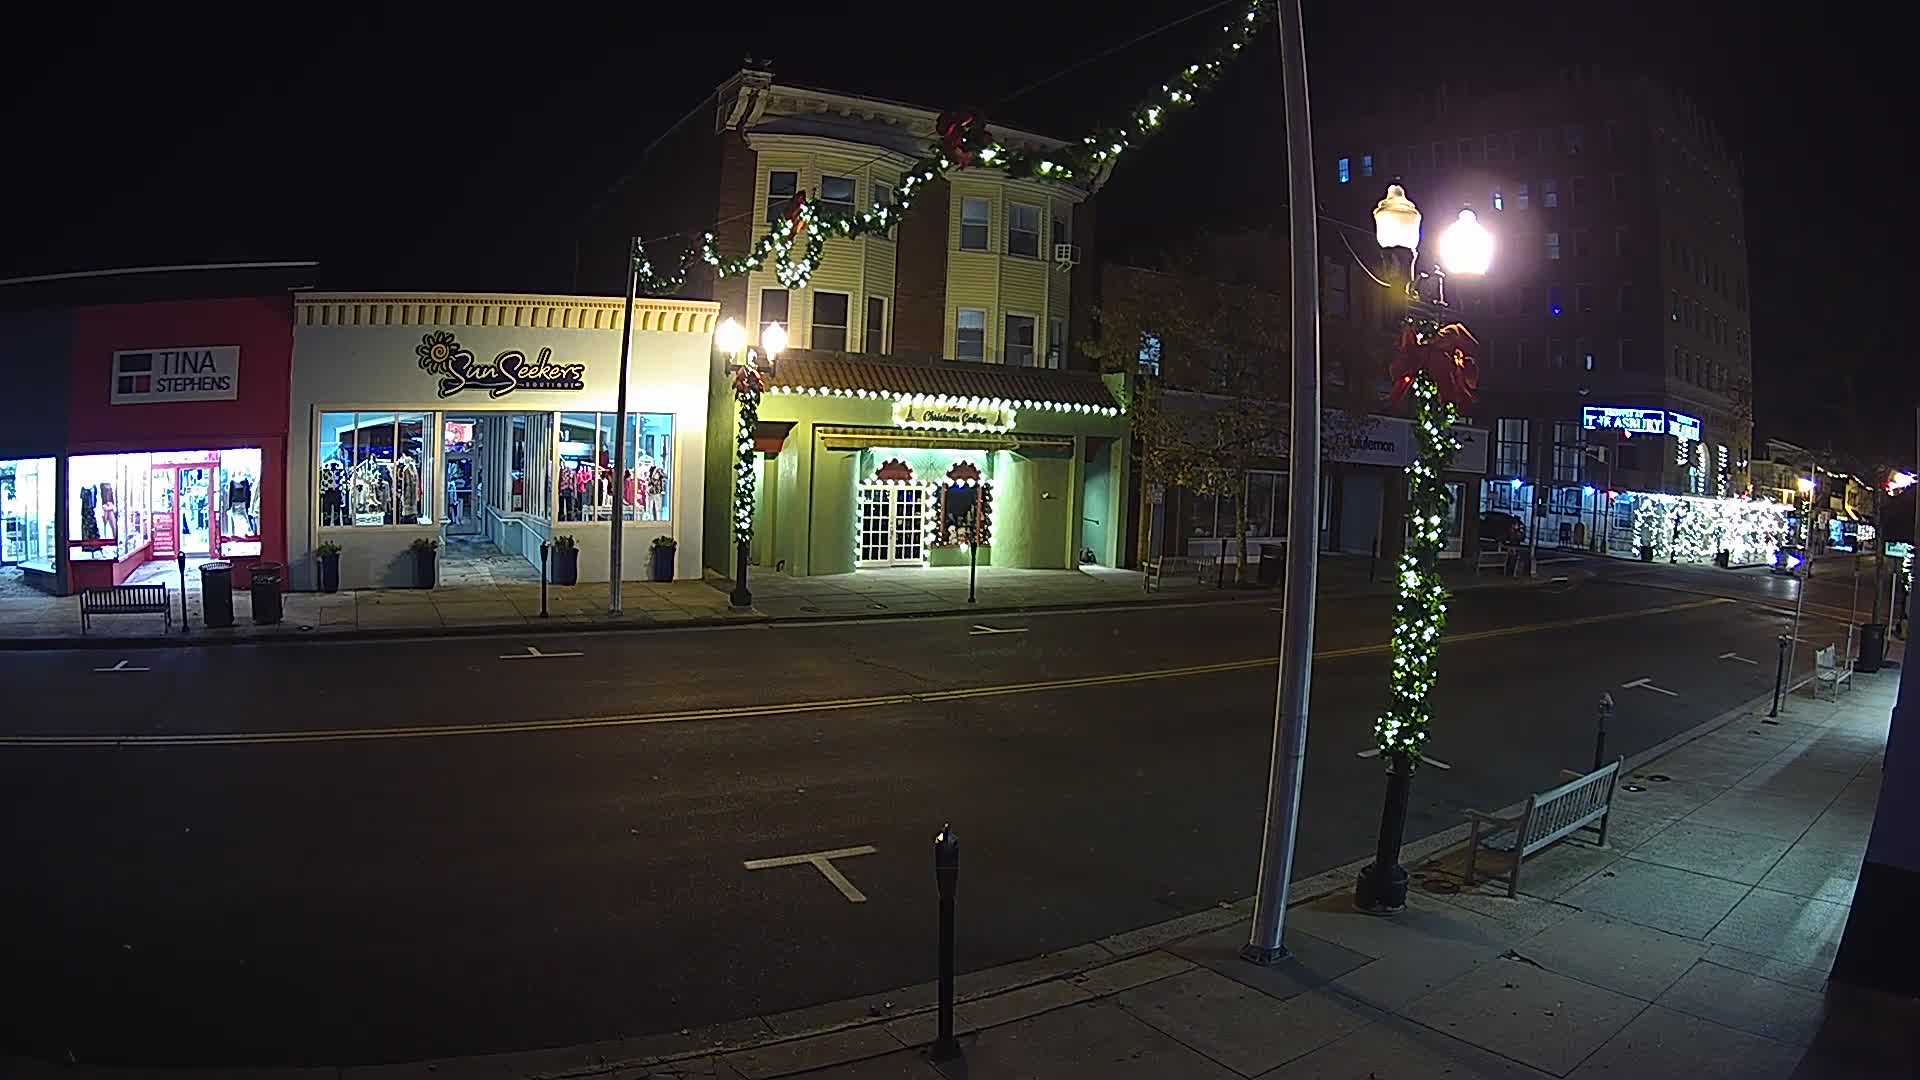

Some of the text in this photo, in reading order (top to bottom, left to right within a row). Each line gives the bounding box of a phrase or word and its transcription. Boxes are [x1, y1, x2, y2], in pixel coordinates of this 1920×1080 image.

[159, 350, 216, 375] TINA
[156, 375, 231, 393] STEPHENS
[922, 410, 960, 423] Christmas
